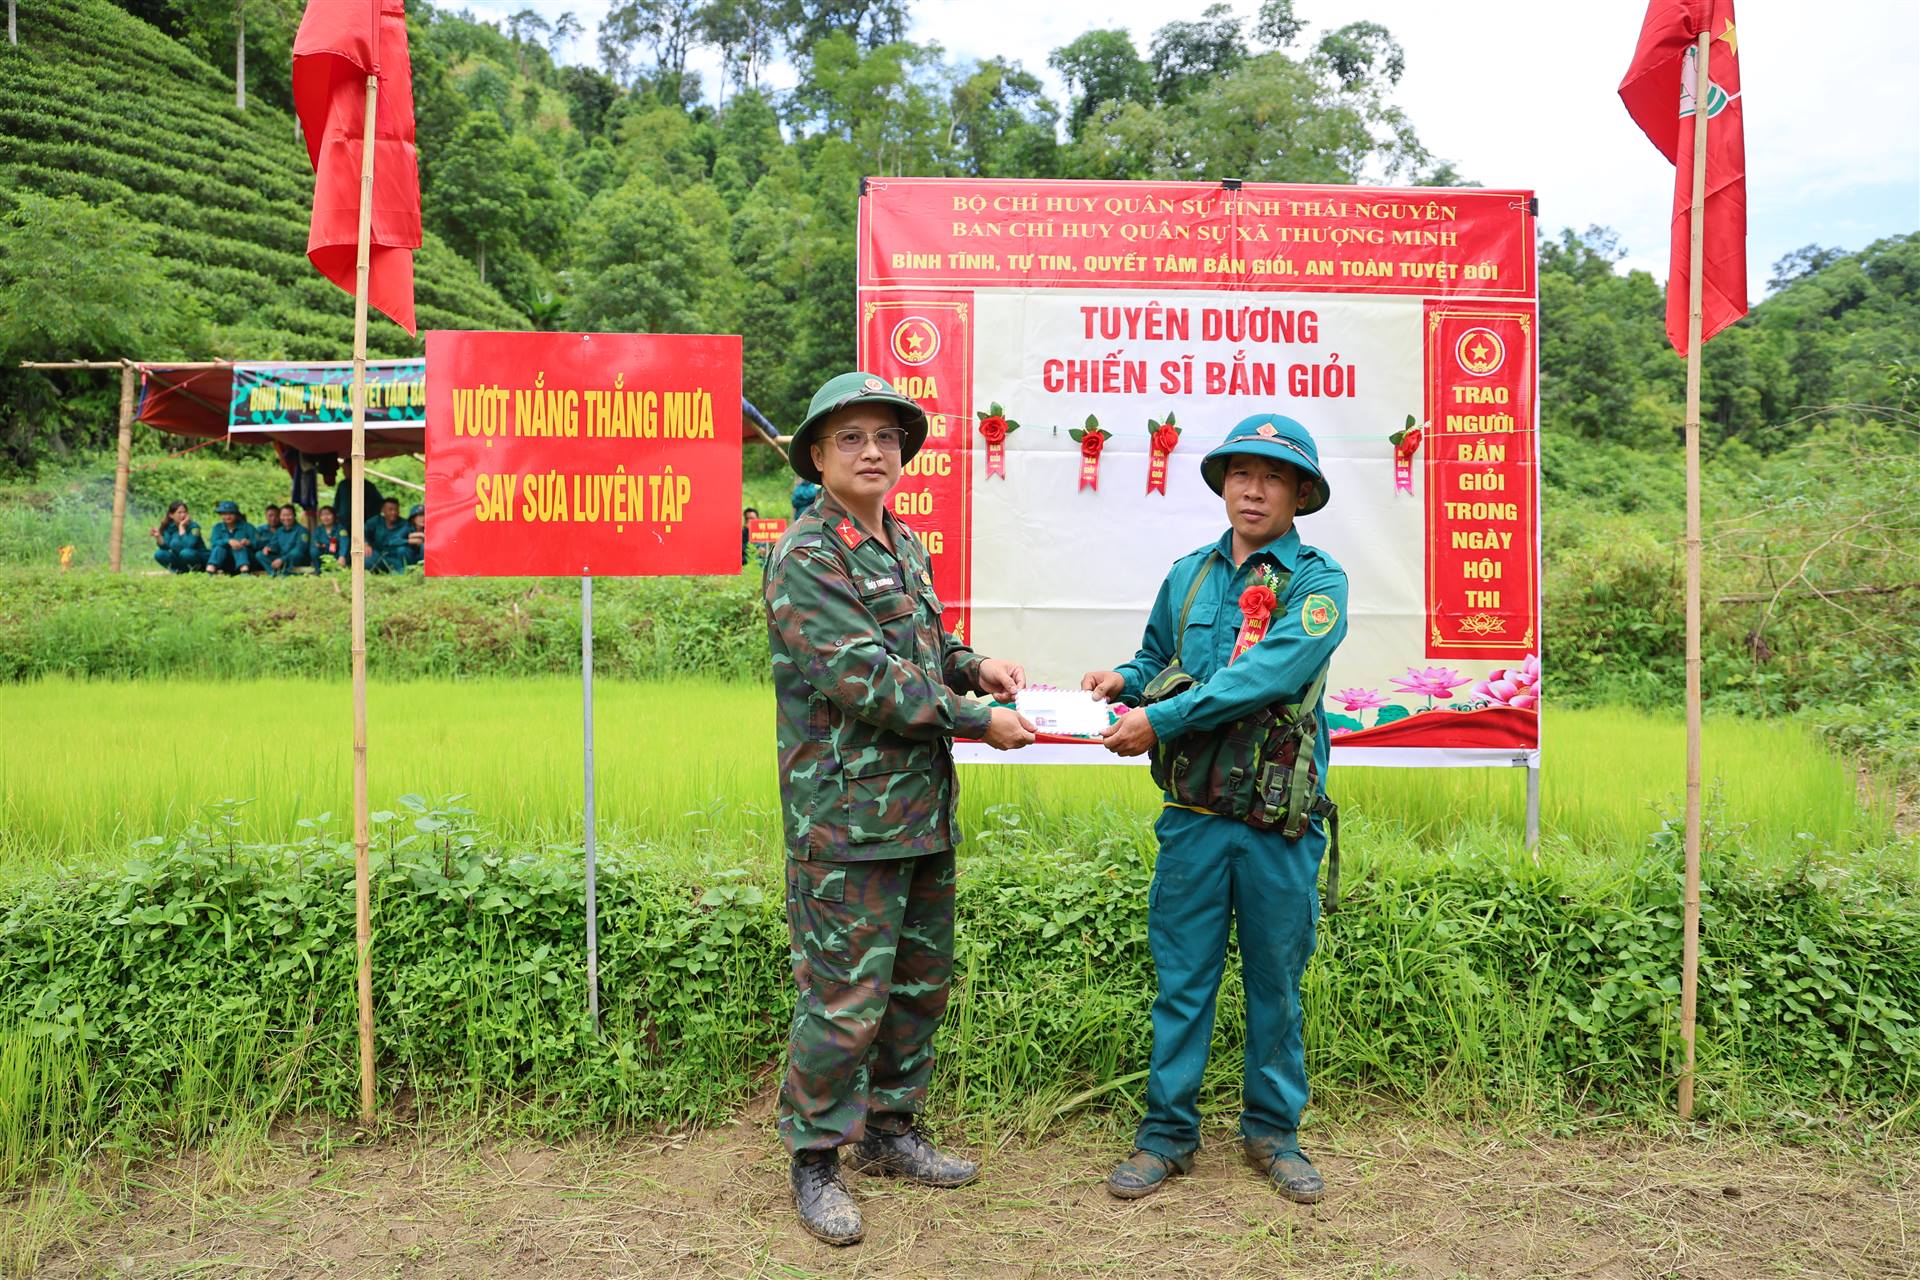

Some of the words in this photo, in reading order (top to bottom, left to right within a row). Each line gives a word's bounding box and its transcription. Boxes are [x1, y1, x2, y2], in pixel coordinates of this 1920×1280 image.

[952, 194, 987, 214] BỘ
[994, 193, 1038, 212] CHỈ
[1046, 197, 1098, 213] HUY
[1105, 194, 1175, 216] QUÂN
[1182, 198, 1215, 218] SỰ
[1220, 197, 1281, 217] TỈNH
[1287, 199, 1347, 218] THÁI
[1355, 201, 1457, 221] NGUYÊN
[952, 222, 1000, 237] BAN
[1009, 218, 1054, 238] CHỈ
[1062, 223, 1114, 238] HUY
[1120, 220, 1190, 242] QUÂN
[1197, 224, 1232, 245] SỰ
[1236, 224, 1271, 242] XÃ
[1276, 225, 1385, 249] THƯỢNG
[1391, 230, 1458, 247] MINH
[892, 251, 942, 269] BÌNH
[948, 251, 1000, 271] TĨNH,
[1007, 253, 1034, 273] TỰ
[1038, 255, 1078, 272] TIN,
[1084, 252, 1147, 273] QUYẾT
[1153, 254, 1198, 273] TÂM
[1204, 252, 1246, 274] BẮN
[1252, 255, 1299, 277] GIỎI,
[1305, 260, 1335, 276] AN
[1340, 259, 1394, 277] TOÀN
[1399, 261, 1459, 282] TUYỆT
[1464, 260, 1499, 280] ĐỐI
[1080, 300, 1190, 342] TUYÊN
[1202, 306, 1319, 344] DƯƠNG
[1043, 349, 1147, 394] CHIẾN
[1160, 354, 1195, 395] SĨ
[1205, 349, 1276, 396] BẮN
[1288, 353, 1356, 398] GIỎI
[893, 377, 938, 399] HOA
[1452, 386, 1509, 404] TRAO
[453, 384, 510, 447] VƯỢT
[515, 372, 579, 438] NẮNG
[584, 373, 658, 438] THẮNG
[663, 387, 715, 439] MƯA
[1446, 412, 1515, 433] NGƯỜI
[900, 449, 951, 476] ƯỚC
[1458, 438, 1506, 462] BẮN
[1459, 468, 1505, 491] GIỎI
[475, 474, 517, 522] SAY
[522, 469, 569, 522] SƯA
[574, 464, 645, 533] LUYỆN
[649, 465, 691, 533] TẬP
[895, 488, 933, 515] GIÓ
[1444, 502, 1518, 521] TRONG
[1452, 528, 1513, 550] NGÀY
[1463, 558, 1502, 582] HỘI
[1465, 590, 1501, 608] THI
